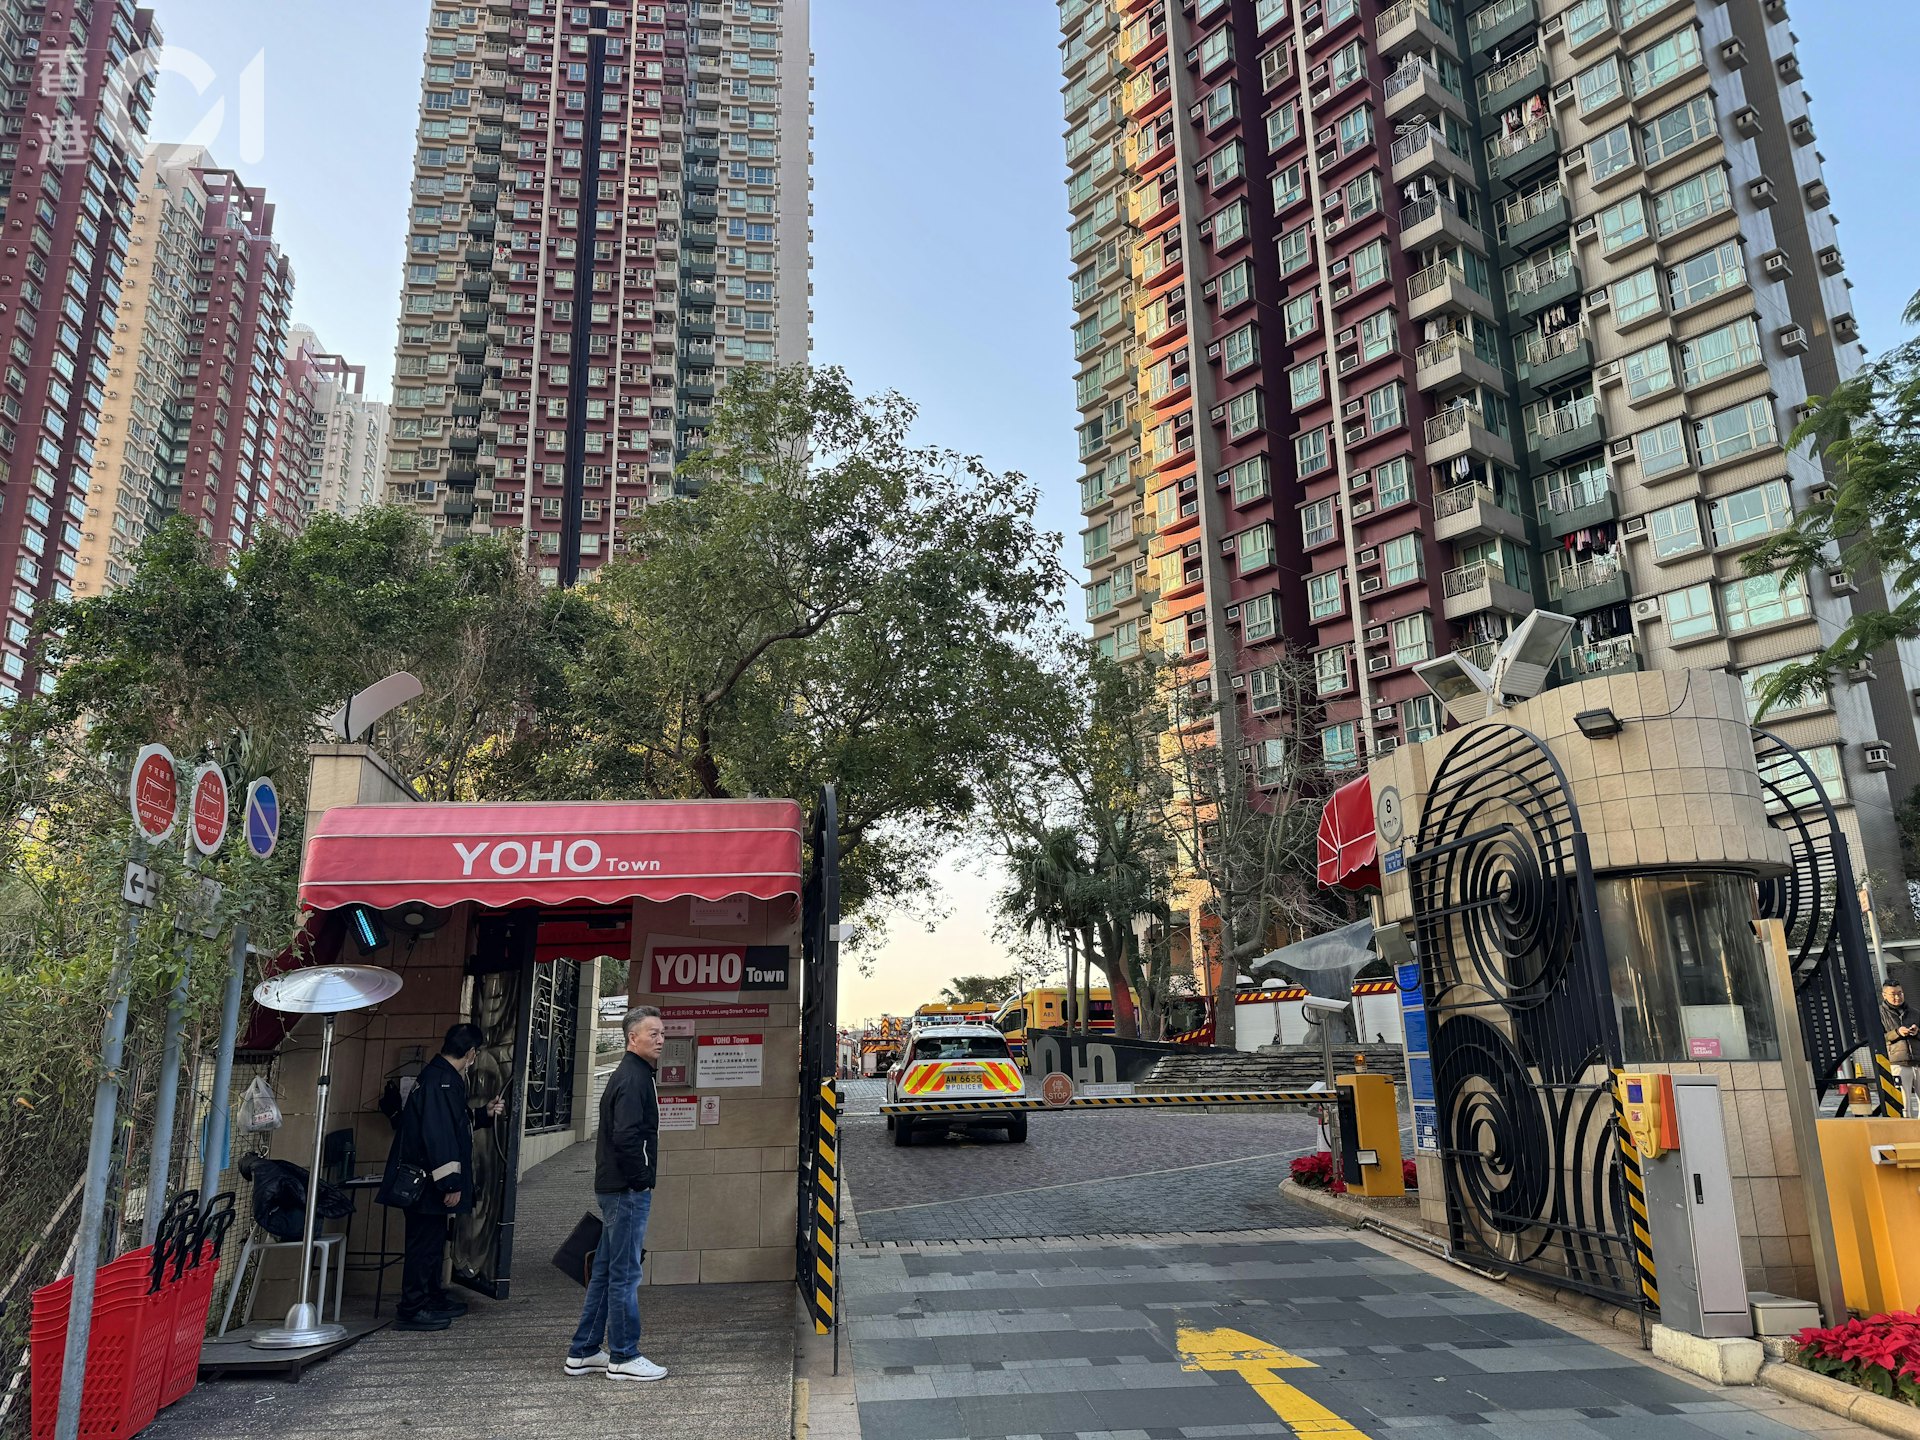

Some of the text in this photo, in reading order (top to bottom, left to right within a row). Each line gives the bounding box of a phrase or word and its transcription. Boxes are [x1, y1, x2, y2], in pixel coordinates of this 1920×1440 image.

[1386, 799, 1392, 813] 8
[140, 809, 167, 825] KEEP CLEAR
[197, 823, 219, 836] KEEP CLEAR
[452, 838, 661, 876] YOHO Town
[655, 953, 785, 985] YOHO Town
[712, 1036, 749, 1045] YOHO Town
[946, 1074, 982, 1083] AM 6655
[1051, 1079, 1063, 1092] 停
[1048, 1092, 1068, 1101] STOP
